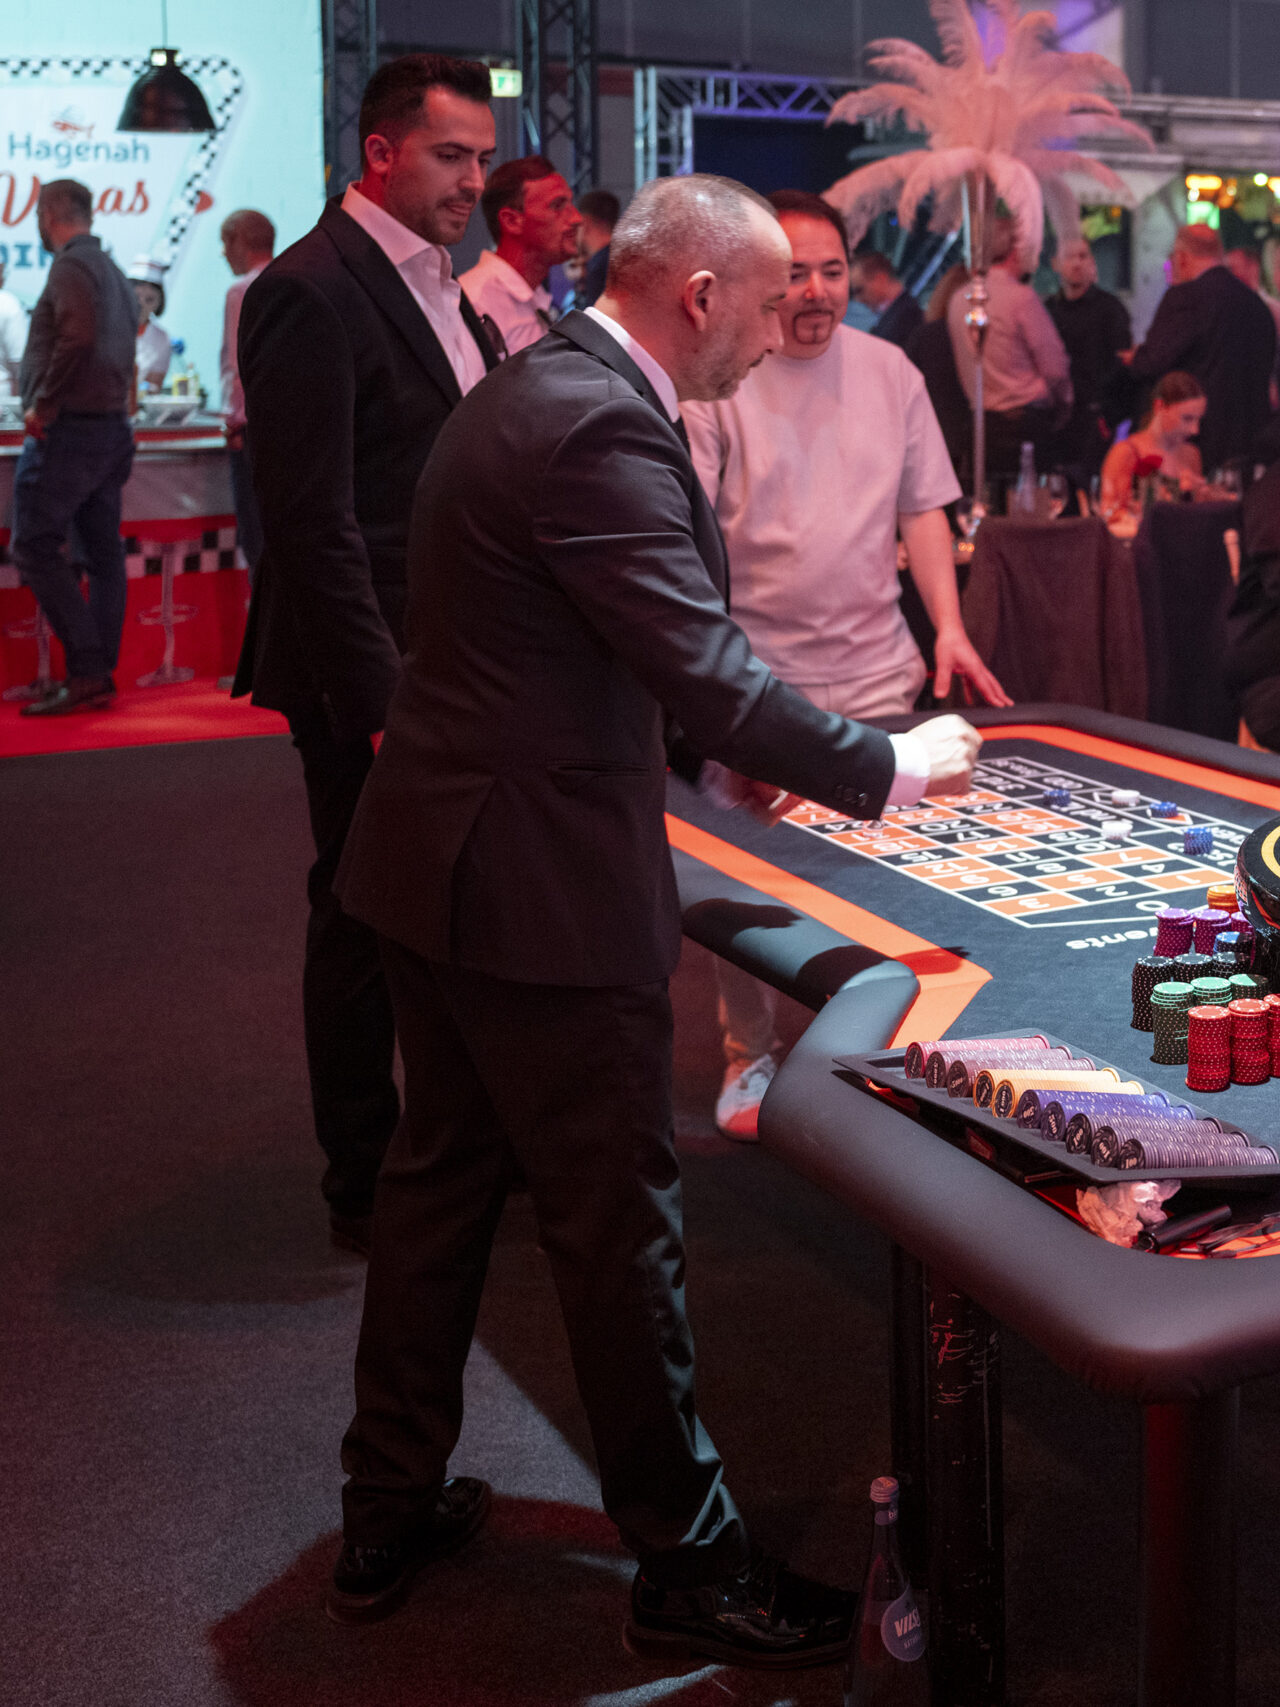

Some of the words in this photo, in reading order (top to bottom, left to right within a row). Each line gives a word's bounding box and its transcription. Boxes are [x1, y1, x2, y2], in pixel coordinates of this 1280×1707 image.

[8, 132, 150, 169] Hagenah
[0, 170, 150, 228] Vas
[966, 803, 1013, 813] 22
[898, 811, 943, 821] 23
[996, 809, 1037, 822] 19
[920, 819, 971, 832] 20
[1021, 821, 1063, 832] 16
[957, 831, 990, 841] 17
[1049, 831, 1091, 842] 13
[873, 840, 920, 851] 18
[976, 841, 1018, 851] 14
[1075, 840, 1121, 852] 10
[901, 851, 943, 863] 15
[1005, 852, 1040, 863] 11
[1118, 852, 1143, 862] 7
[924, 862, 968, 873] 12
[1035, 862, 1067, 873] 8
[1141, 863, 1165, 873] 4
[960, 874, 990, 885] 9
[1067, 874, 1097, 885] 5
[1176, 874, 1200, 884] 1
[987, 886, 1018, 897] 6
[1095, 885, 1129, 897] 2
[1018, 898, 1050, 909] 3
[1135, 900, 1170, 912] 0
[1048, 1113, 1058, 1134] 500
[1073, 1128, 1084, 1146] 100
[1099, 1141, 1110, 1159] 100
[1125, 1157, 1138, 1169] 100
